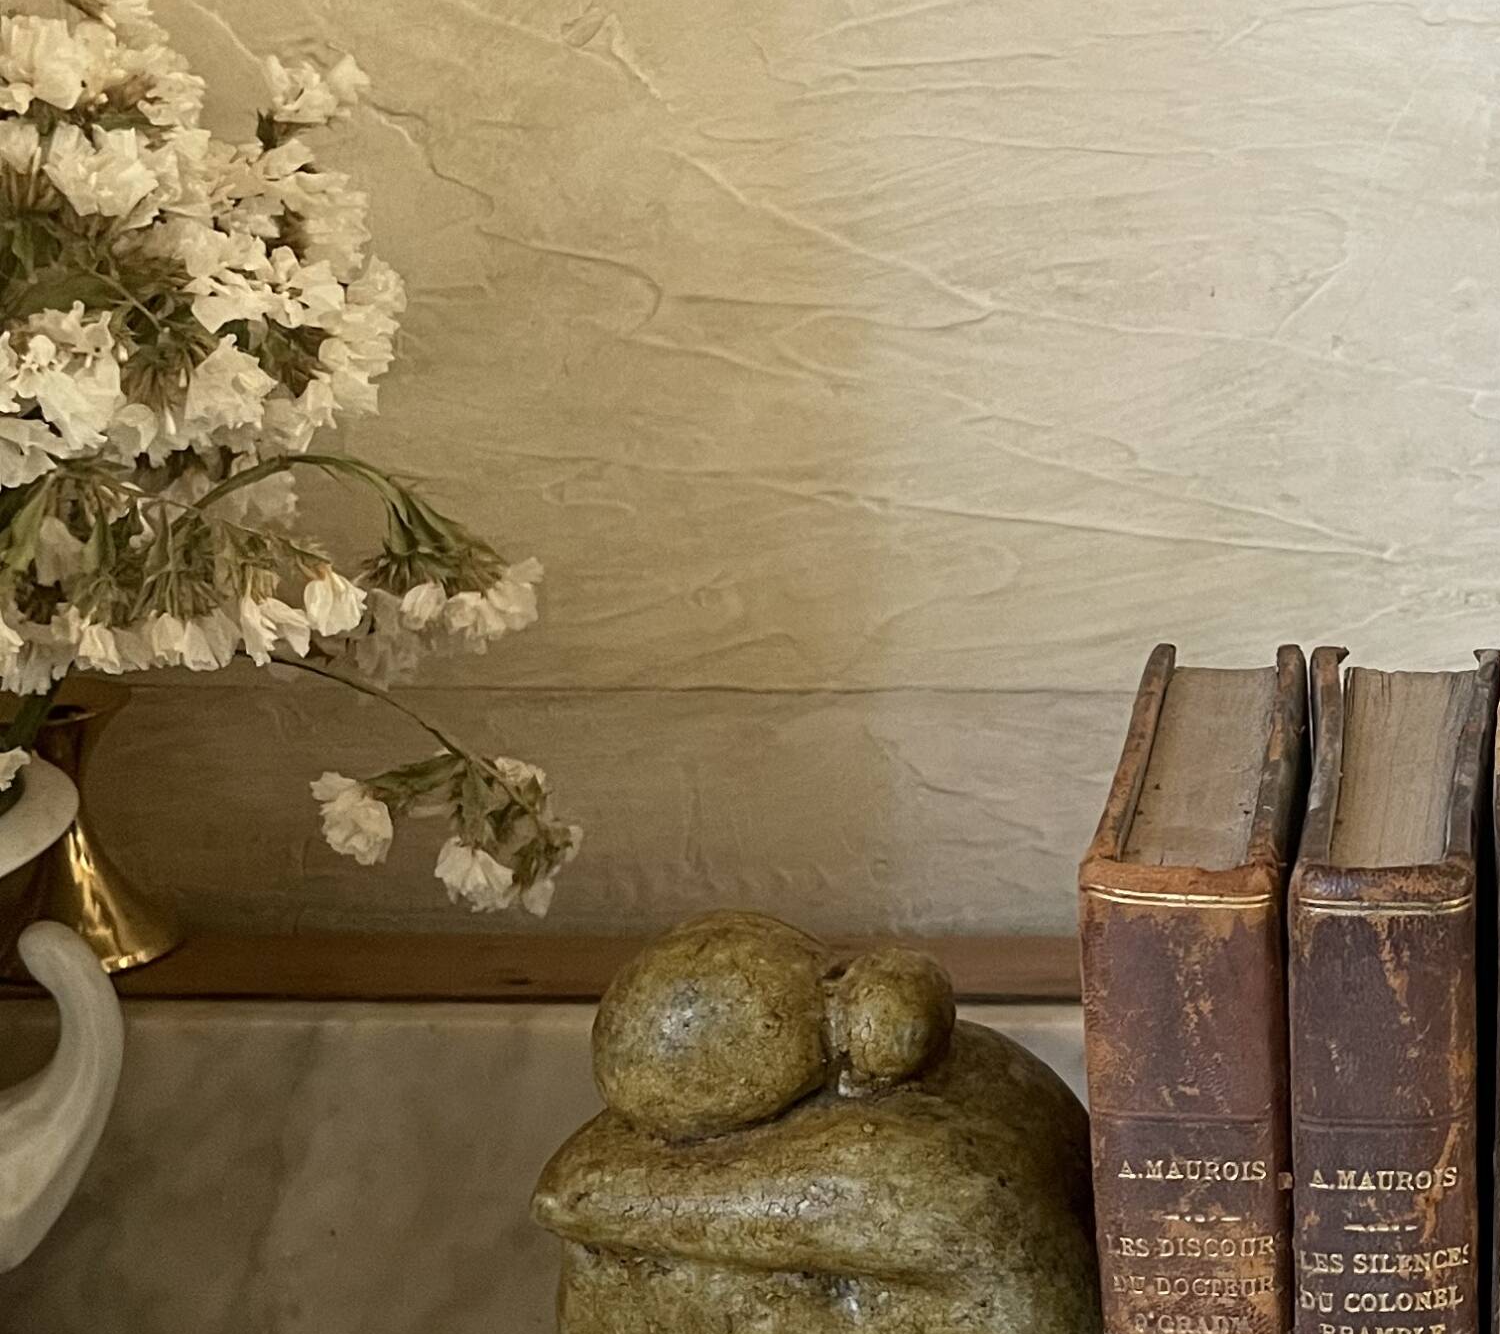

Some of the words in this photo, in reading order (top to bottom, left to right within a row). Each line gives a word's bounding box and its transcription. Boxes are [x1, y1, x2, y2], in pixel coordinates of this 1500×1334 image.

[1105, 1233, 1151, 1258] LES
[1299, 1249, 1345, 1274] LES
[1155, 1274, 1275, 1298] DOCTEUR
[1300, 1283, 1335, 1313] DU
[1343, 1284, 1464, 1314] COLONEL
